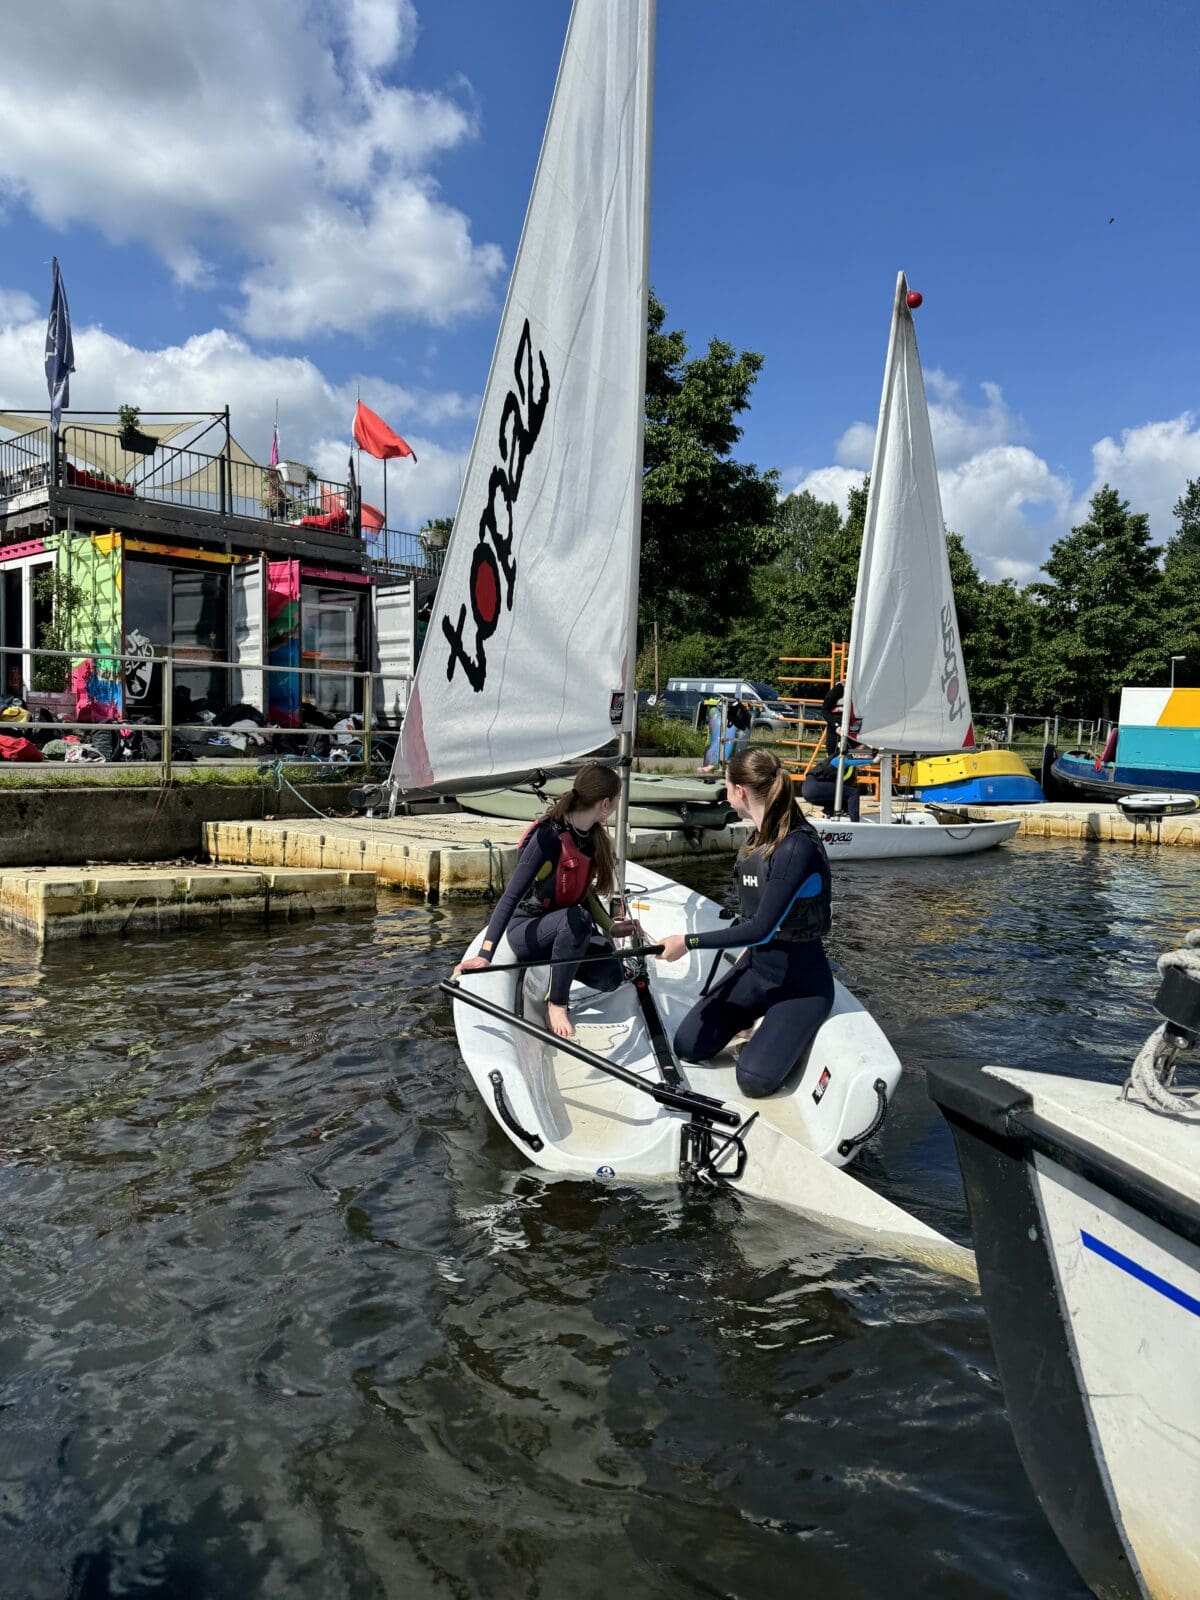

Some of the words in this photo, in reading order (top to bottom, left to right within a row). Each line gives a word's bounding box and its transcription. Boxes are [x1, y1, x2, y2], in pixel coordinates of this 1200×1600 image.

[442, 318, 550, 692] topaz
[819, 829, 853, 845] topaz
[743, 874, 758, 887] HH
